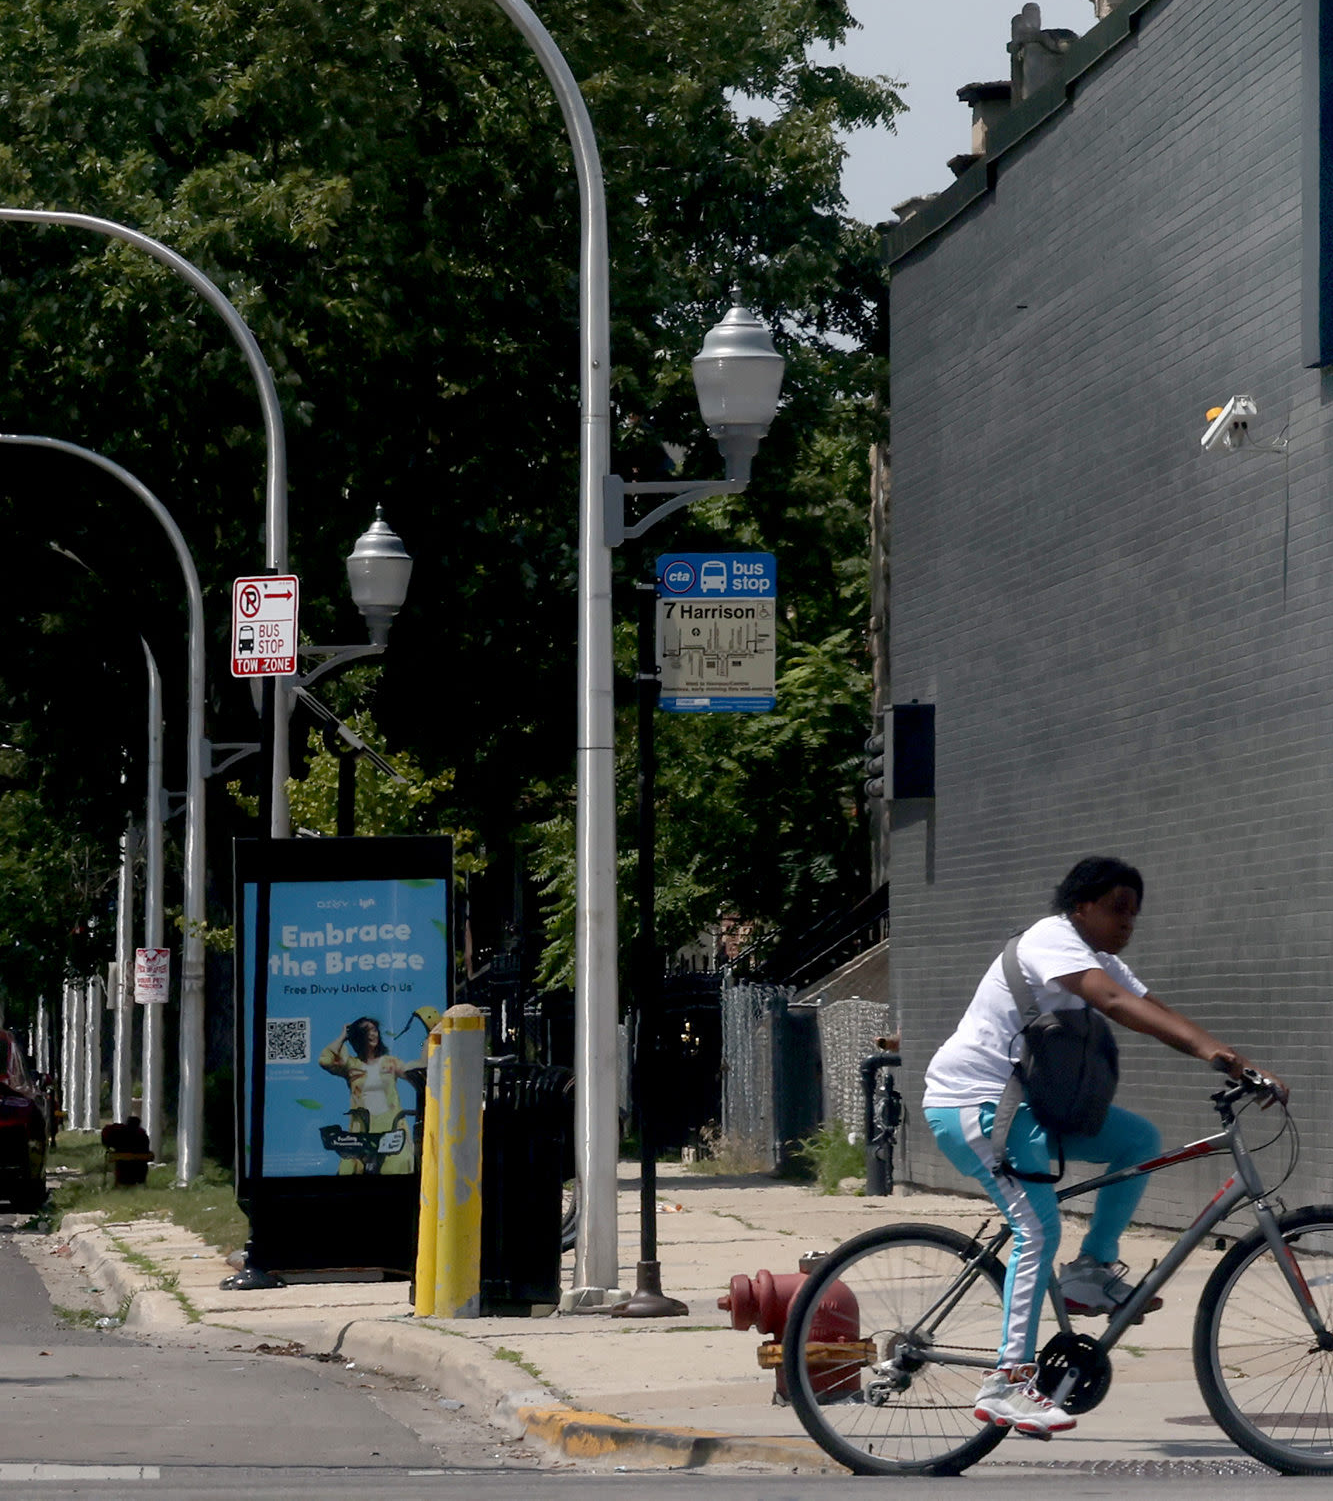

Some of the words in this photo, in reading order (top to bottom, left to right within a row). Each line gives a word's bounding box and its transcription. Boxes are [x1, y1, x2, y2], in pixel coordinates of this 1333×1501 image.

[733, 560, 764, 575] bus
[669, 572, 690, 582] cta
[732, 576, 770, 593] stop
[664, 602, 676, 619] 7
[680, 604, 756, 619] Harrison
[259, 624, 280, 638] BUS
[258, 639, 284, 654] STOP
[237, 659, 259, 673] TOW
[264, 657, 292, 672] ZONE
[282, 922, 412, 948] Embrace
[268, 952, 318, 977] the
[325, 950, 425, 975] Breeze
[283, 985, 307, 996] Free
[310, 984, 339, 996] Divvy
[341, 982, 378, 994] Unlock
[380, 982, 397, 994] On
